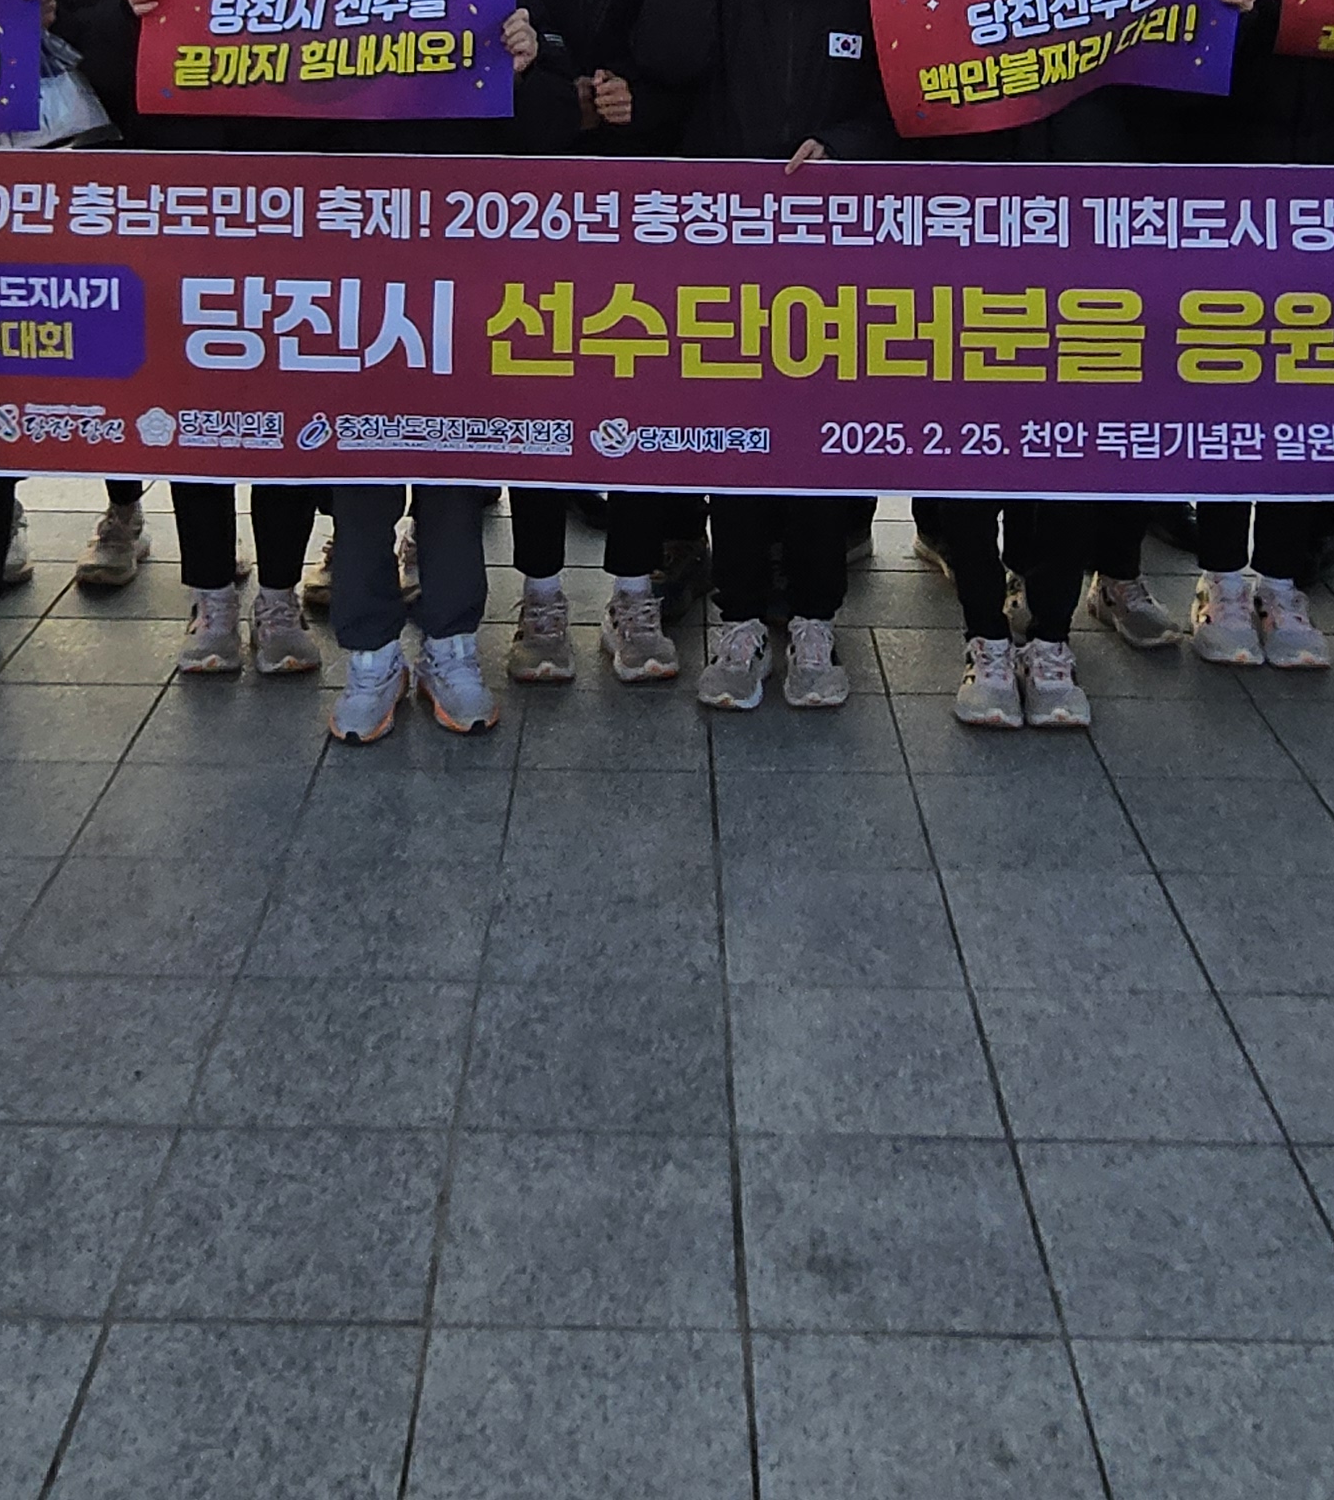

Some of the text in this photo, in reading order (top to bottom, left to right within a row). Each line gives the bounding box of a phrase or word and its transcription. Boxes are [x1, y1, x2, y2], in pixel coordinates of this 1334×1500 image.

[174, 30, 475, 88] 끝까지 힘내세요!
[918, 3, 1199, 105] 백만불짜리 다리!
[68, 183, 304, 238] 충남도민의
[315, 185, 431, 240] 축제!
[444, 190, 620, 243] 2026년
[631, 190, 1070, 248] 충청남도민체육대회
[1082, 196, 1278, 250] 개최도시
[181, 276, 455, 374] 당진시
[486, 281, 1146, 382] 선수단여러분을
[179, 411, 284, 436] 당진시의회
[336, 414, 573, 443] 충청남도당진교육지원청
[636, 426, 770, 454] 당진시체육회
[821, 422, 913, 455] 2025.
[923, 422, 952, 455] 2.
[961, 423, 1010, 455] 25.
[1021, 420, 1089, 458] 천안
[1095, 422, 1266, 460] 독립기념관
